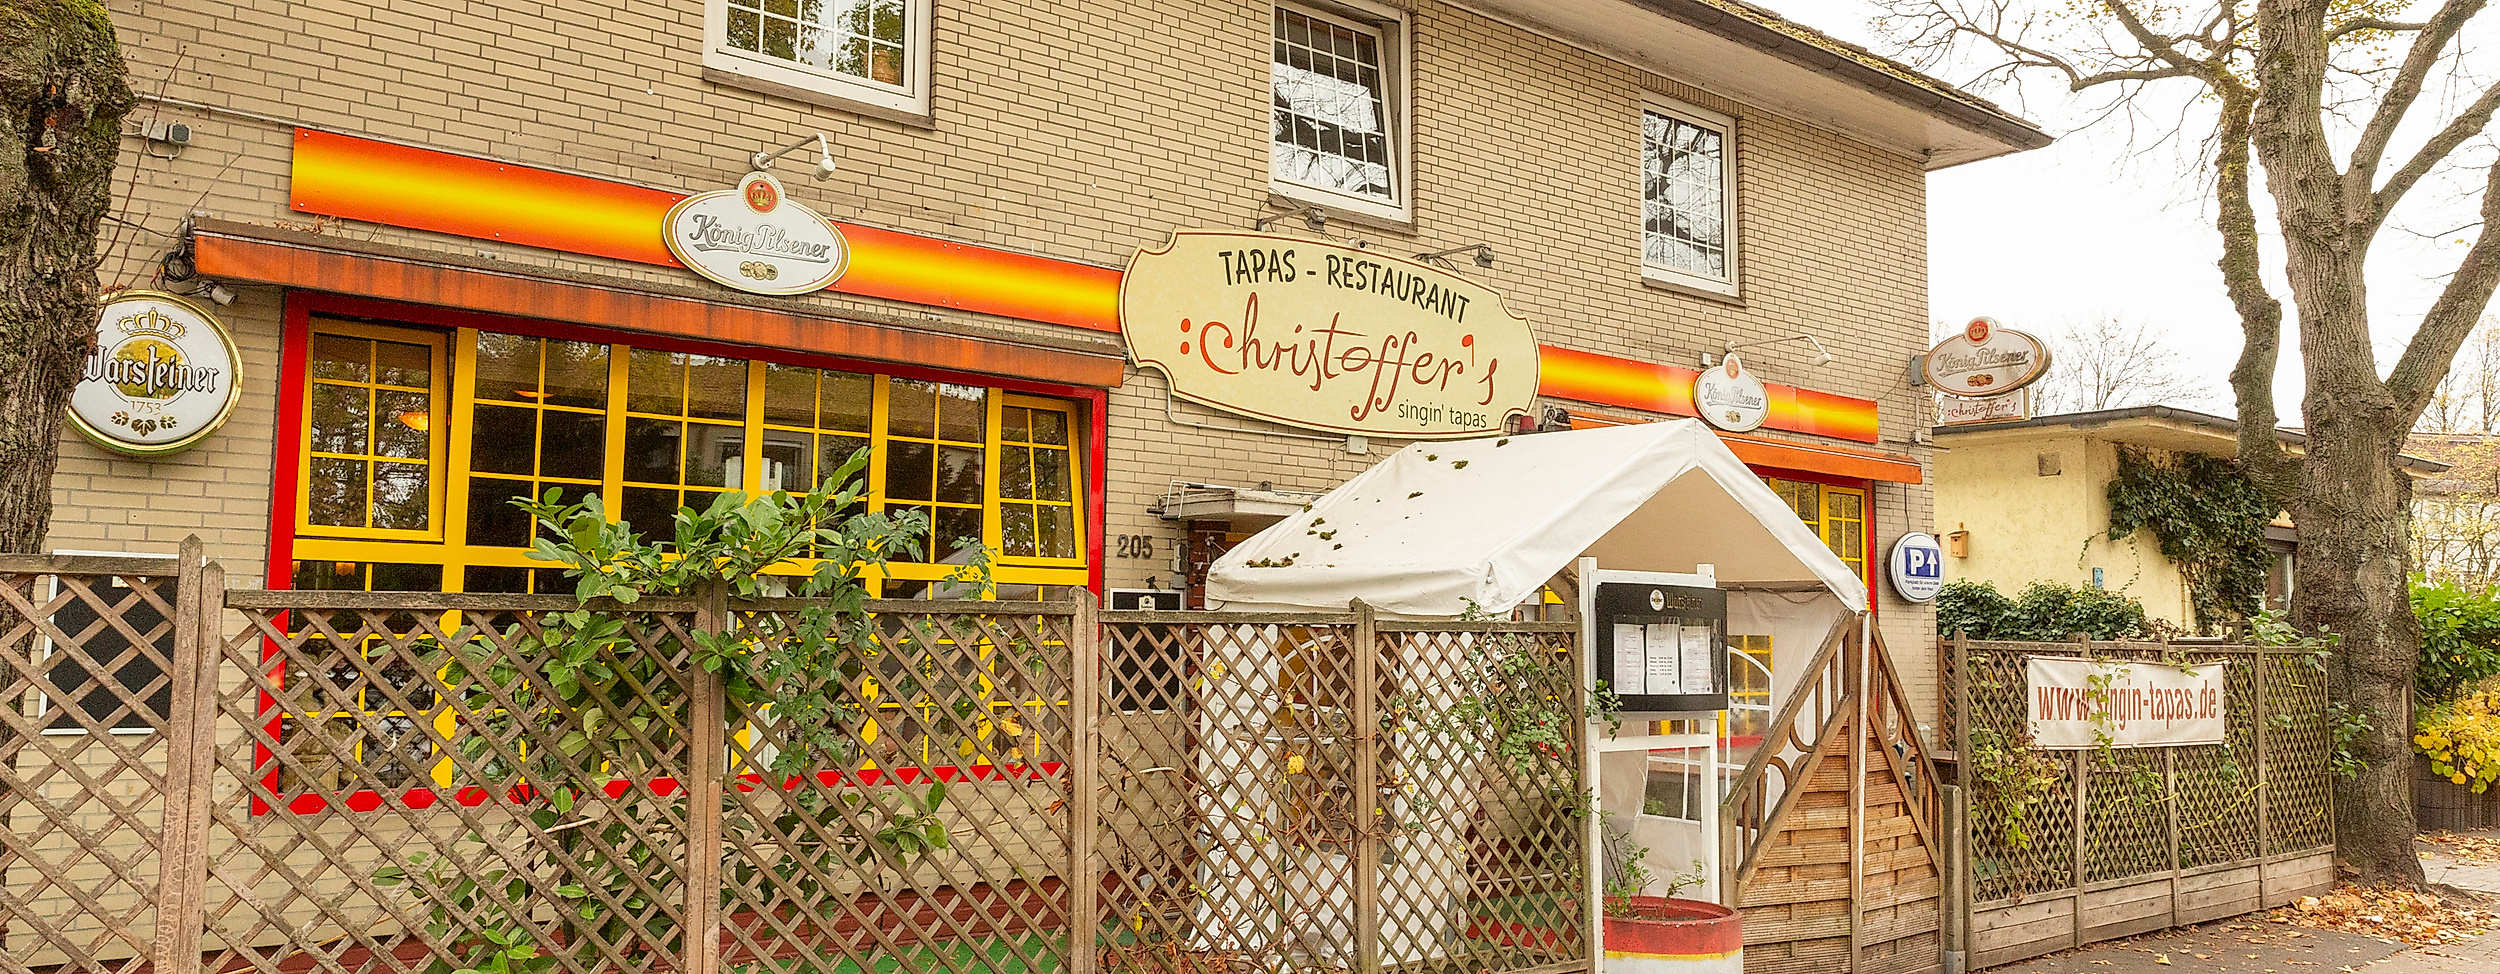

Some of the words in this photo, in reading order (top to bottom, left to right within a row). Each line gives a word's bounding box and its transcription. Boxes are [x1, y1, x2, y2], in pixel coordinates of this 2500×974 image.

[689, 214, 754, 252] König
[754, 224, 830, 258] Pilsener
[1219, 249, 1296, 286] TAPAS
[1326, 254, 1470, 324] RESTAURANT
[1936, 353, 1975, 373] König
[1974, 348, 2029, 369] Pilsener
[130, 400, 162, 416] 1753
[1398, 399, 1444, 427] singin'
[1449, 405, 1488, 431] tapas
[1117, 534, 1153, 559] 205
[1910, 549, 1925, 575] P
[2037, 679, 2217, 731] wwwsingin-tapas.de
